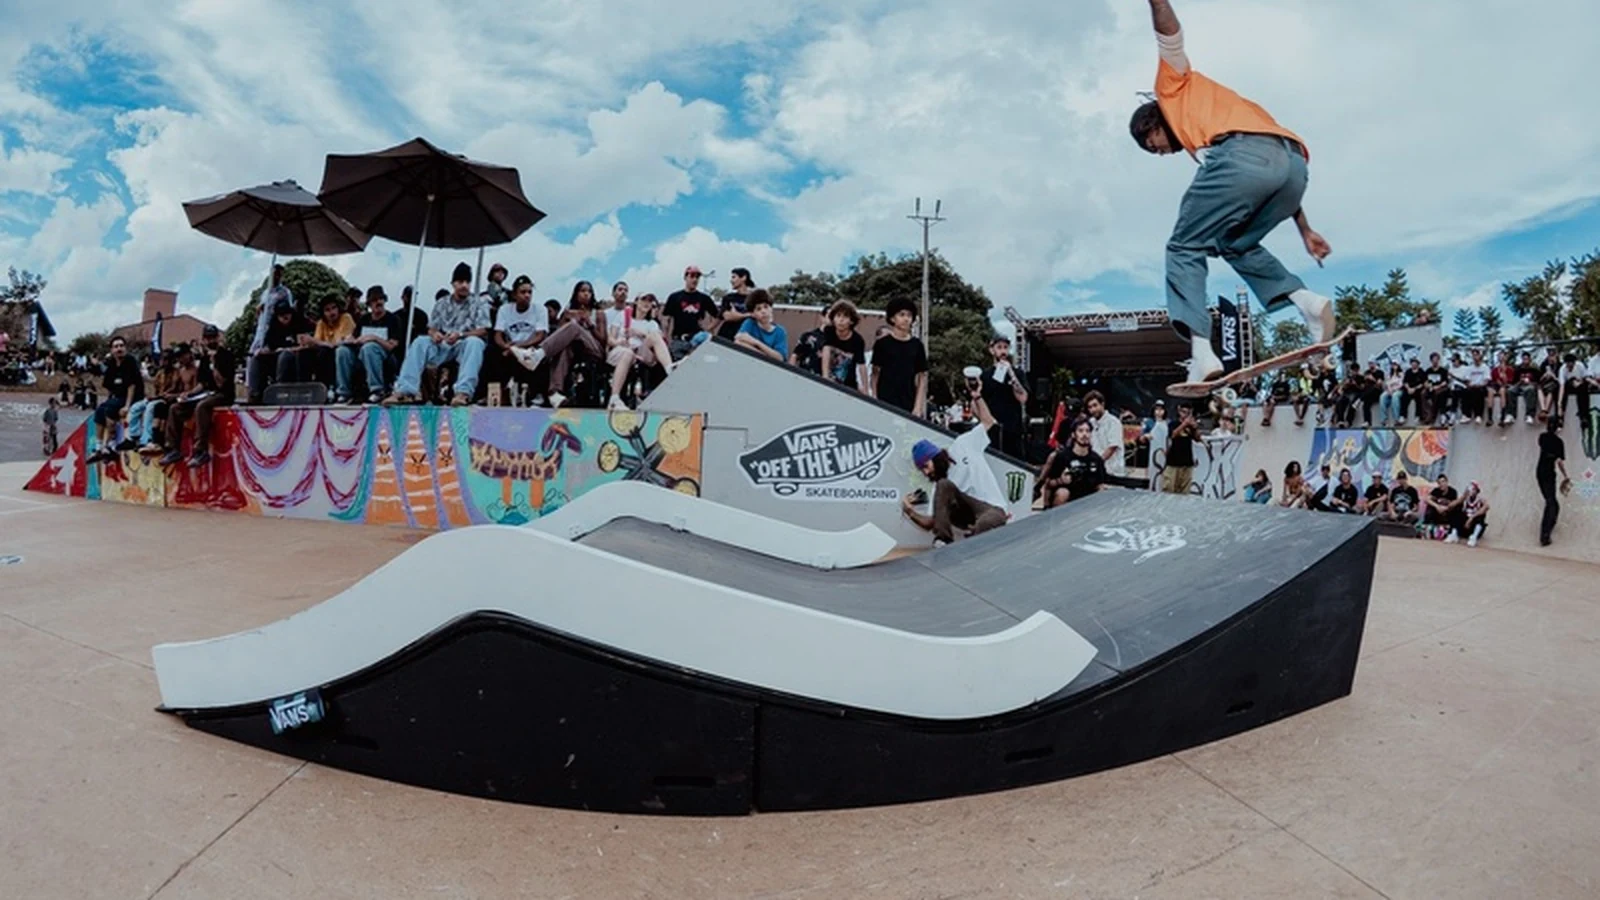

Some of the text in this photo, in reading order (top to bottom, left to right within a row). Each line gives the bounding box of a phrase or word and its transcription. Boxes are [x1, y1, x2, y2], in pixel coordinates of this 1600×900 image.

[1222, 313, 1237, 361] VANS
[783, 425, 839, 455] VANS
[792, 449, 835, 477] THE
[805, 487, 897, 499] SKATEBOARDING
[268, 696, 310, 732] VANS
